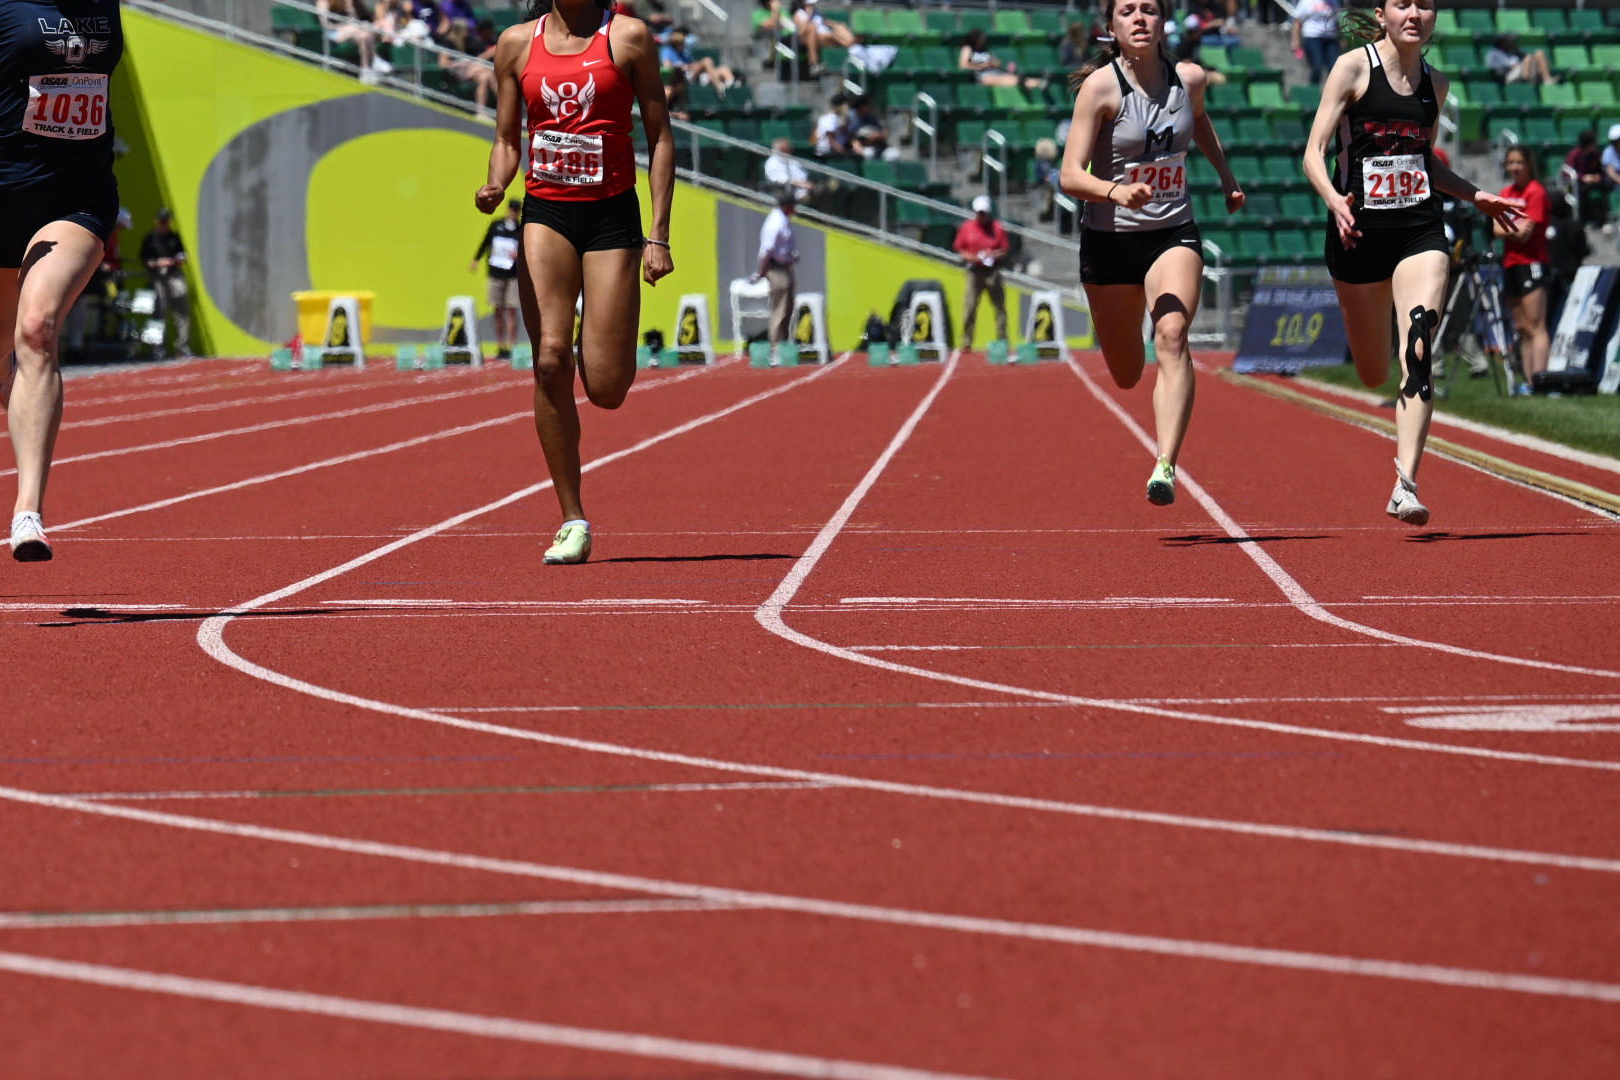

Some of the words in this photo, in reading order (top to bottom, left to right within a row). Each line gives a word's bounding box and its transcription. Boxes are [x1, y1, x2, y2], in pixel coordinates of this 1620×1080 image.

[37, 16, 111, 35] LAKE
[41, 76, 68, 86] OSAA
[72, 76, 102, 86] OnPoint
[558, 82, 578, 98] O
[33, 93, 104, 126] 1036
[560, 100, 579, 116] C
[34, 122, 66, 134] TRACK
[67, 126, 74, 135] &
[77, 127, 99, 136] FIELD
[1144, 126, 1173, 154] M
[538, 147, 599, 176] 1486
[540, 171, 564, 181] TRACK
[573, 176, 595, 184] FIELD
[1130, 166, 1183, 191] 1264
[1368, 171, 1427, 198] 2192
[1404, 196, 1424, 204] FIELD
[680, 312, 696, 346] 5
[913, 311, 930, 342] 3
[1034, 309, 1051, 341] 2
[1269, 311, 1325, 347] 10.9
